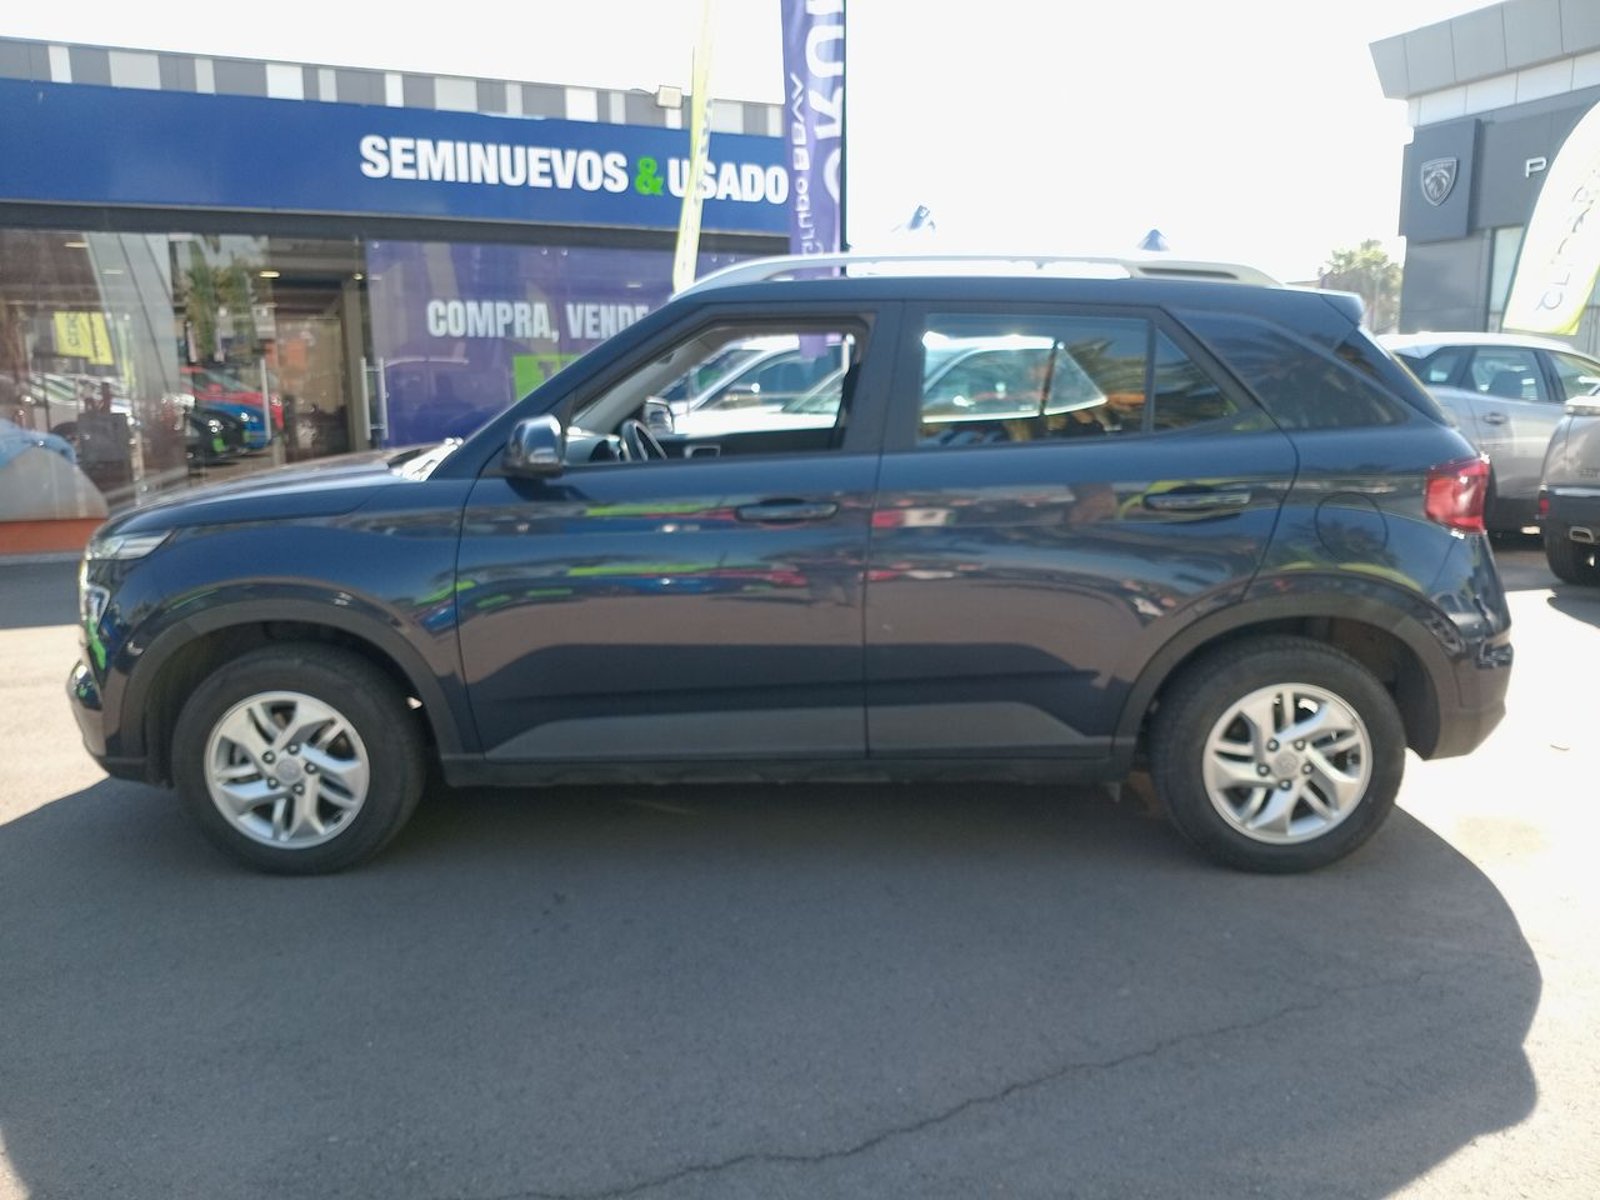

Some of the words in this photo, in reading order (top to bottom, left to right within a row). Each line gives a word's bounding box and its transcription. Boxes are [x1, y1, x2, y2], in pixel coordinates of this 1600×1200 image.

[359, 134, 629, 194] SEMINUEVOS
[635, 155, 664, 196] &
[427, 299, 560, 341] COMPRA,
